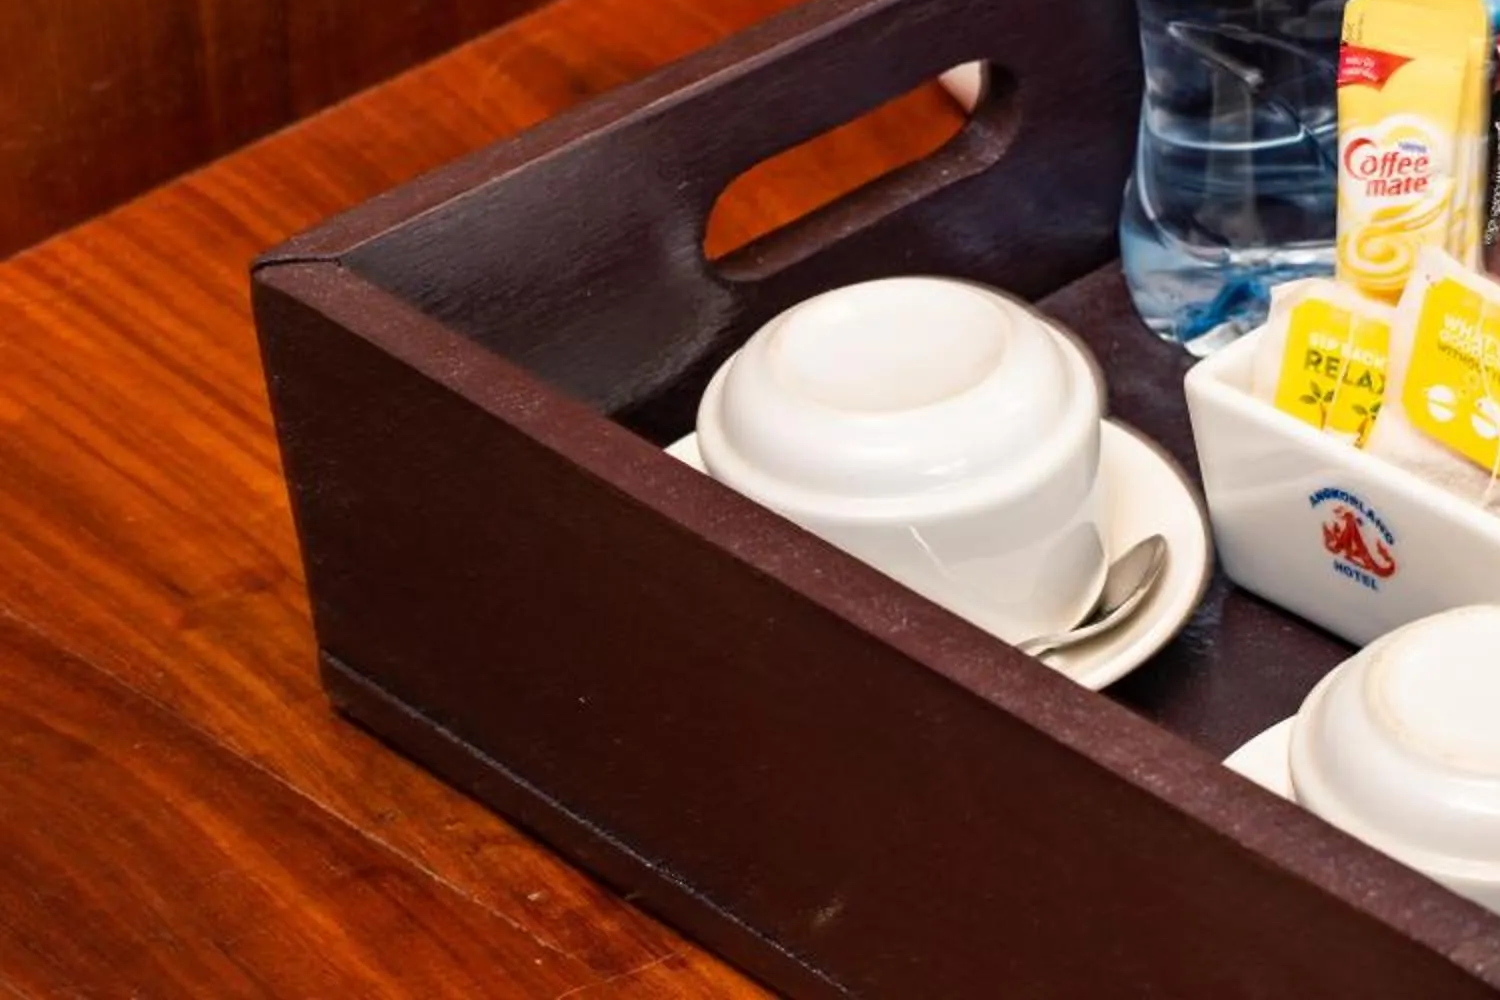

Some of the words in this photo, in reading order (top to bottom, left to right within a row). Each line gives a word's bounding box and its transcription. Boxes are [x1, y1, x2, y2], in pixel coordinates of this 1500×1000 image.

[1344, 137, 1428, 181] Coffee
[1366, 177, 1427, 197] mate
[1334, 560, 1379, 591] HOTEL
